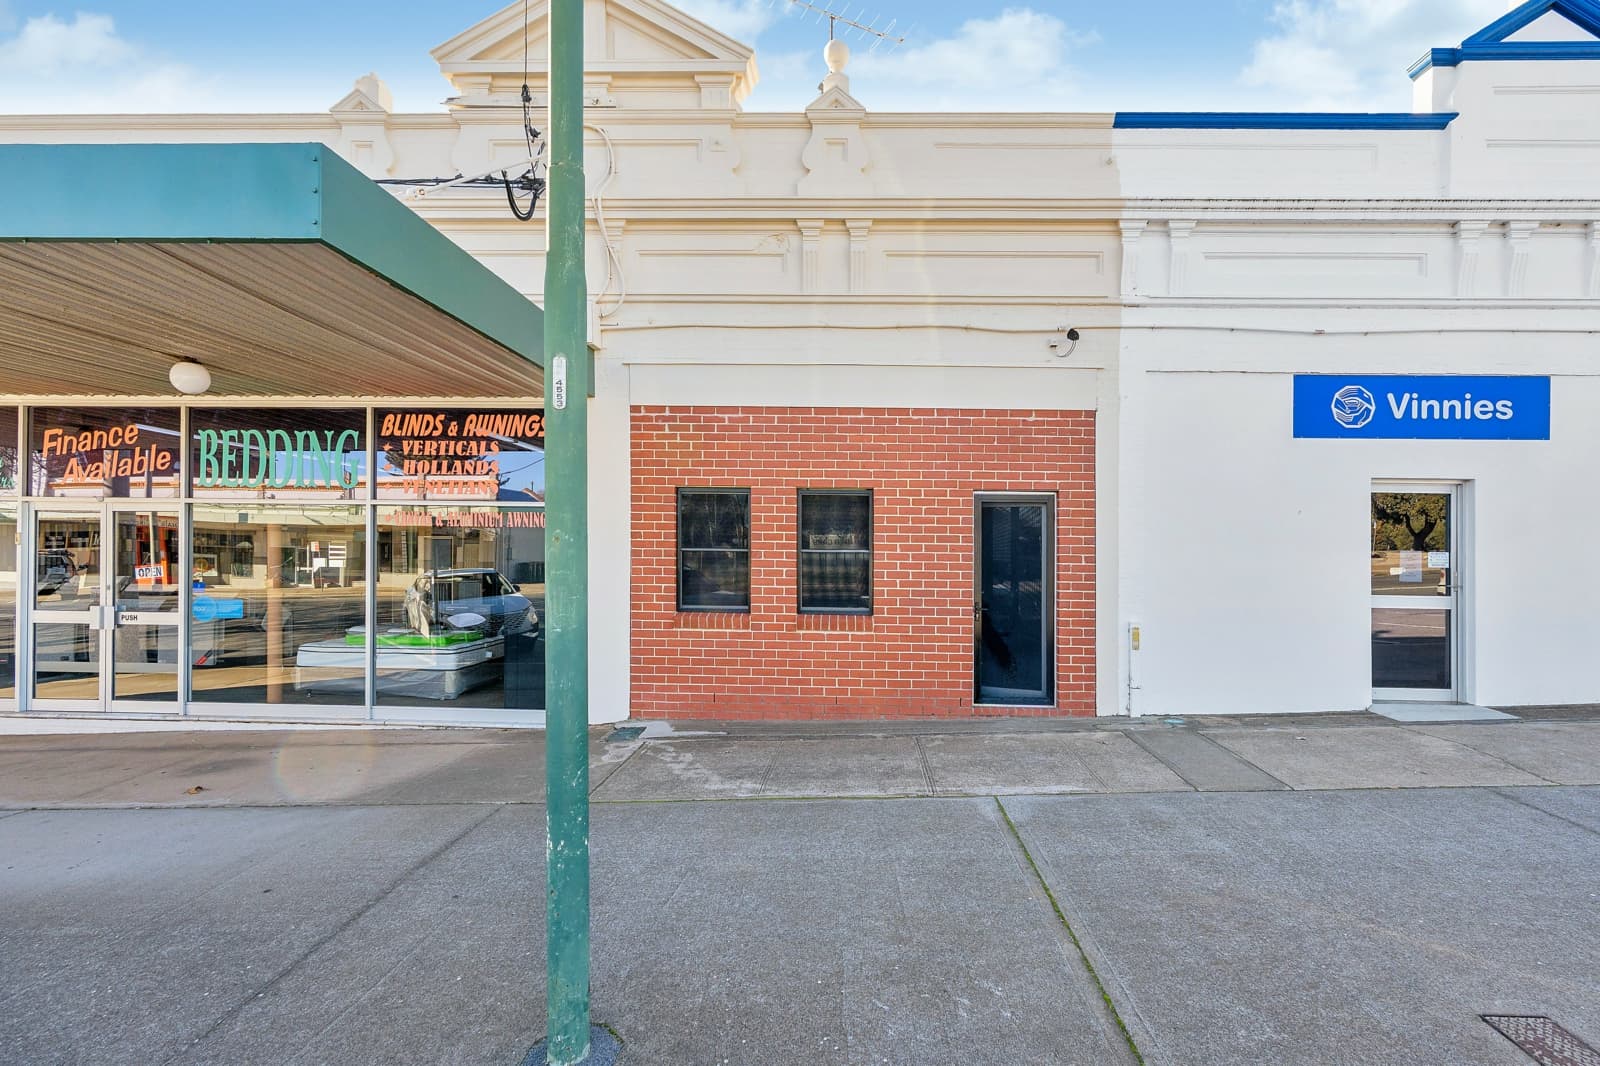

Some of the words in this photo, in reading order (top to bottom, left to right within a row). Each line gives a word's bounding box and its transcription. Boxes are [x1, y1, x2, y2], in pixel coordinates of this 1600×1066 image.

[1387, 393, 1513, 420] Vinnies
[381, 414, 446, 437] BLINDS
[447, 421, 459, 437] &
[43, 423, 139, 458] Finance
[402, 440, 500, 456] VERTICALS
[61, 444, 171, 484] Available
[197, 429, 359, 489] BEDDING
[403, 459, 499, 475] HOLLANDS
[402, 479, 499, 495] VENETIANS
[138, 567, 162, 577] OPEN
